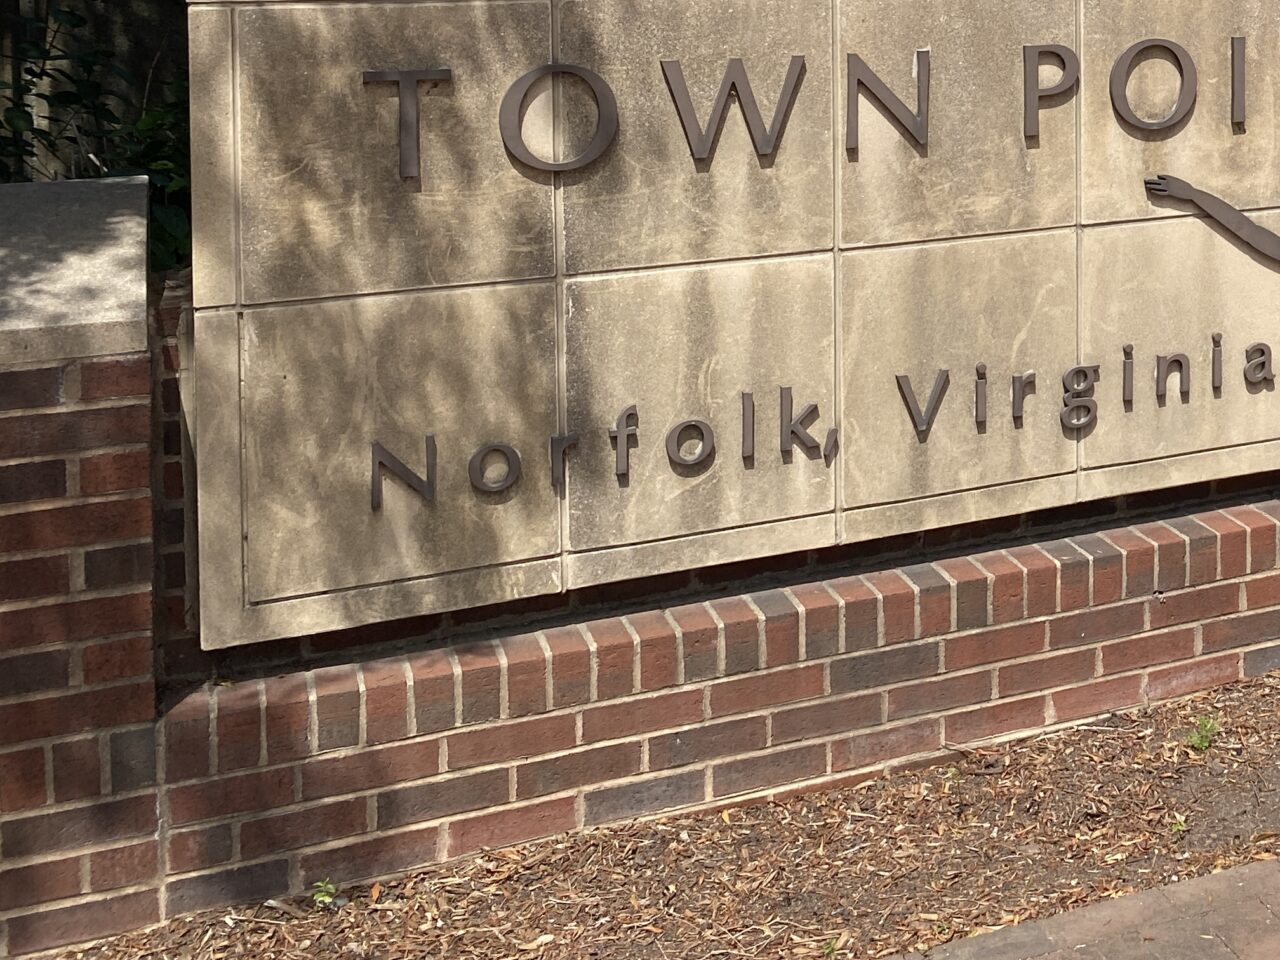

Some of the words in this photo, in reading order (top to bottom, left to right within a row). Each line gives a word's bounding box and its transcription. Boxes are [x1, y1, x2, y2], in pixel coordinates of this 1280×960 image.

[363, 49, 930, 179] TOWN
[371, 384, 840, 512] Norfolk,
[896, 331, 1275, 434] Virginia
